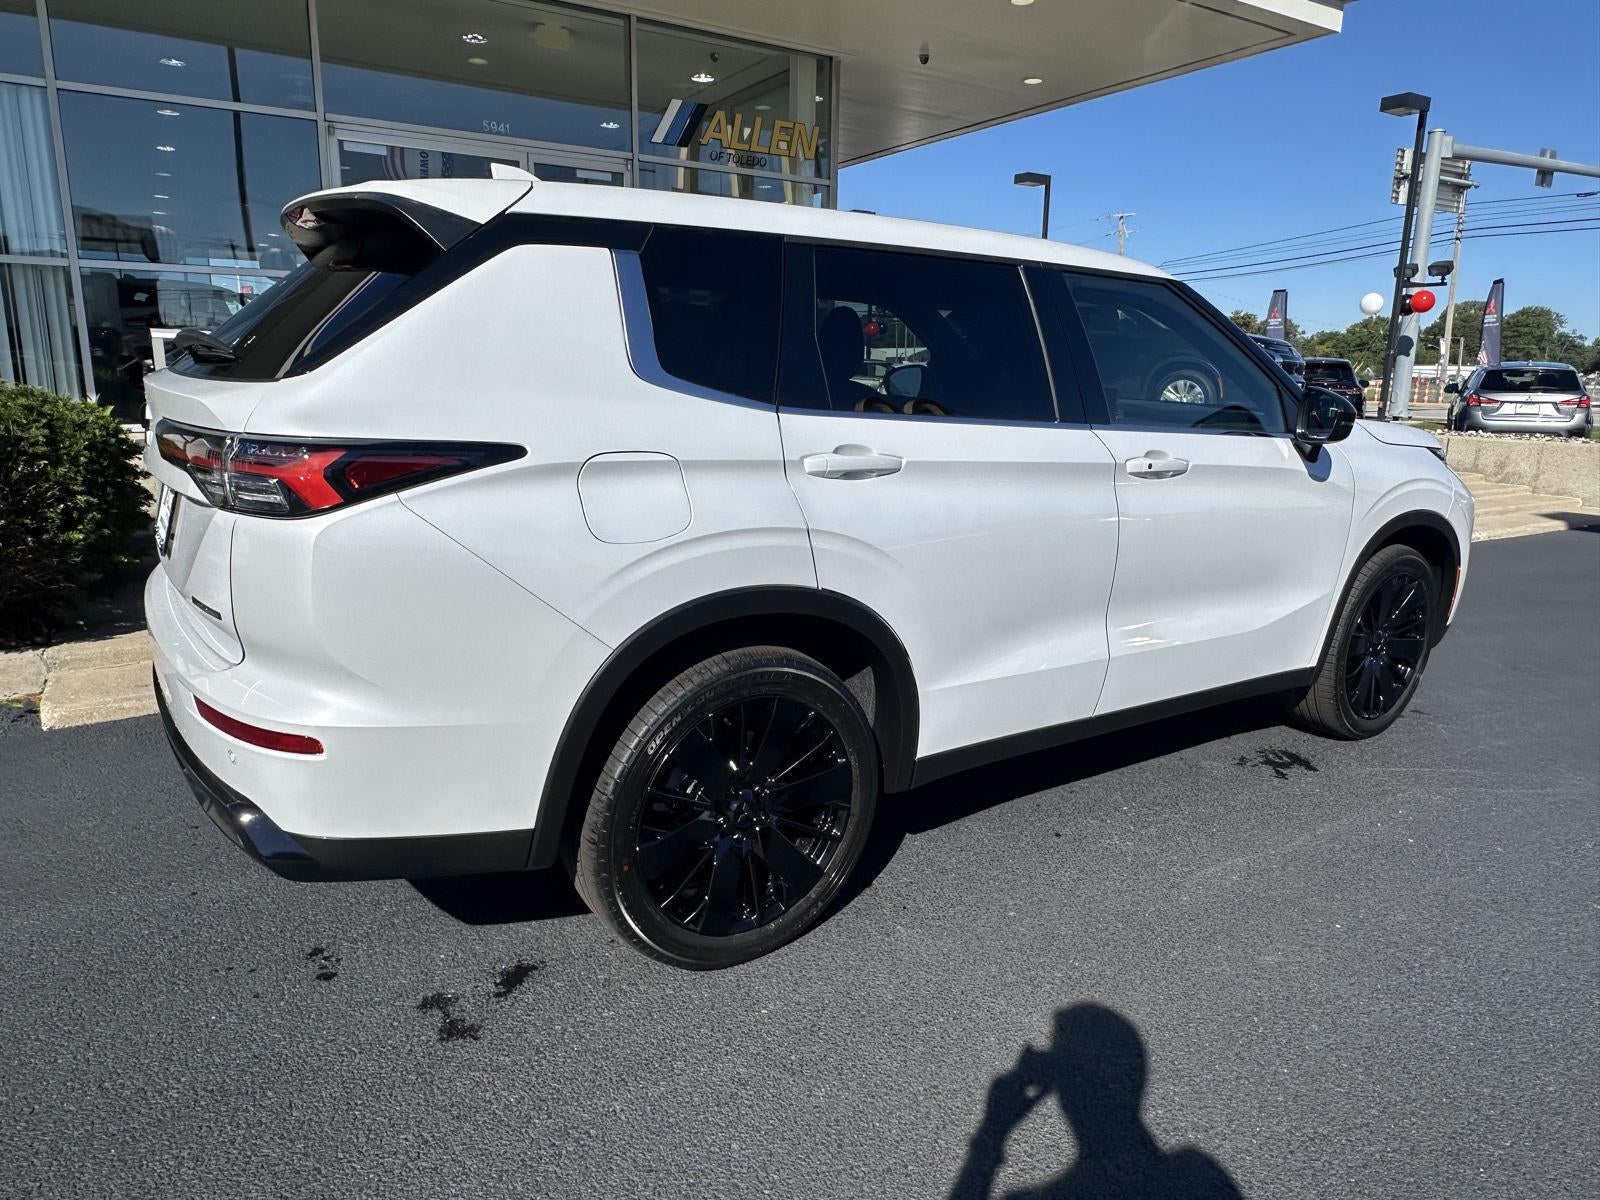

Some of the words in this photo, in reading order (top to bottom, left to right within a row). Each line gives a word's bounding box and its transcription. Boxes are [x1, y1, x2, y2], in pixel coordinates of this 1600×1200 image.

[482, 119, 511, 134] 5941
[699, 109, 820, 161] ALLEN
[419, 151, 429, 178] OWN
[709, 150, 725, 162] OF
[726, 151, 768, 168] TOLEDO
[647, 714, 683, 756] OPEN
